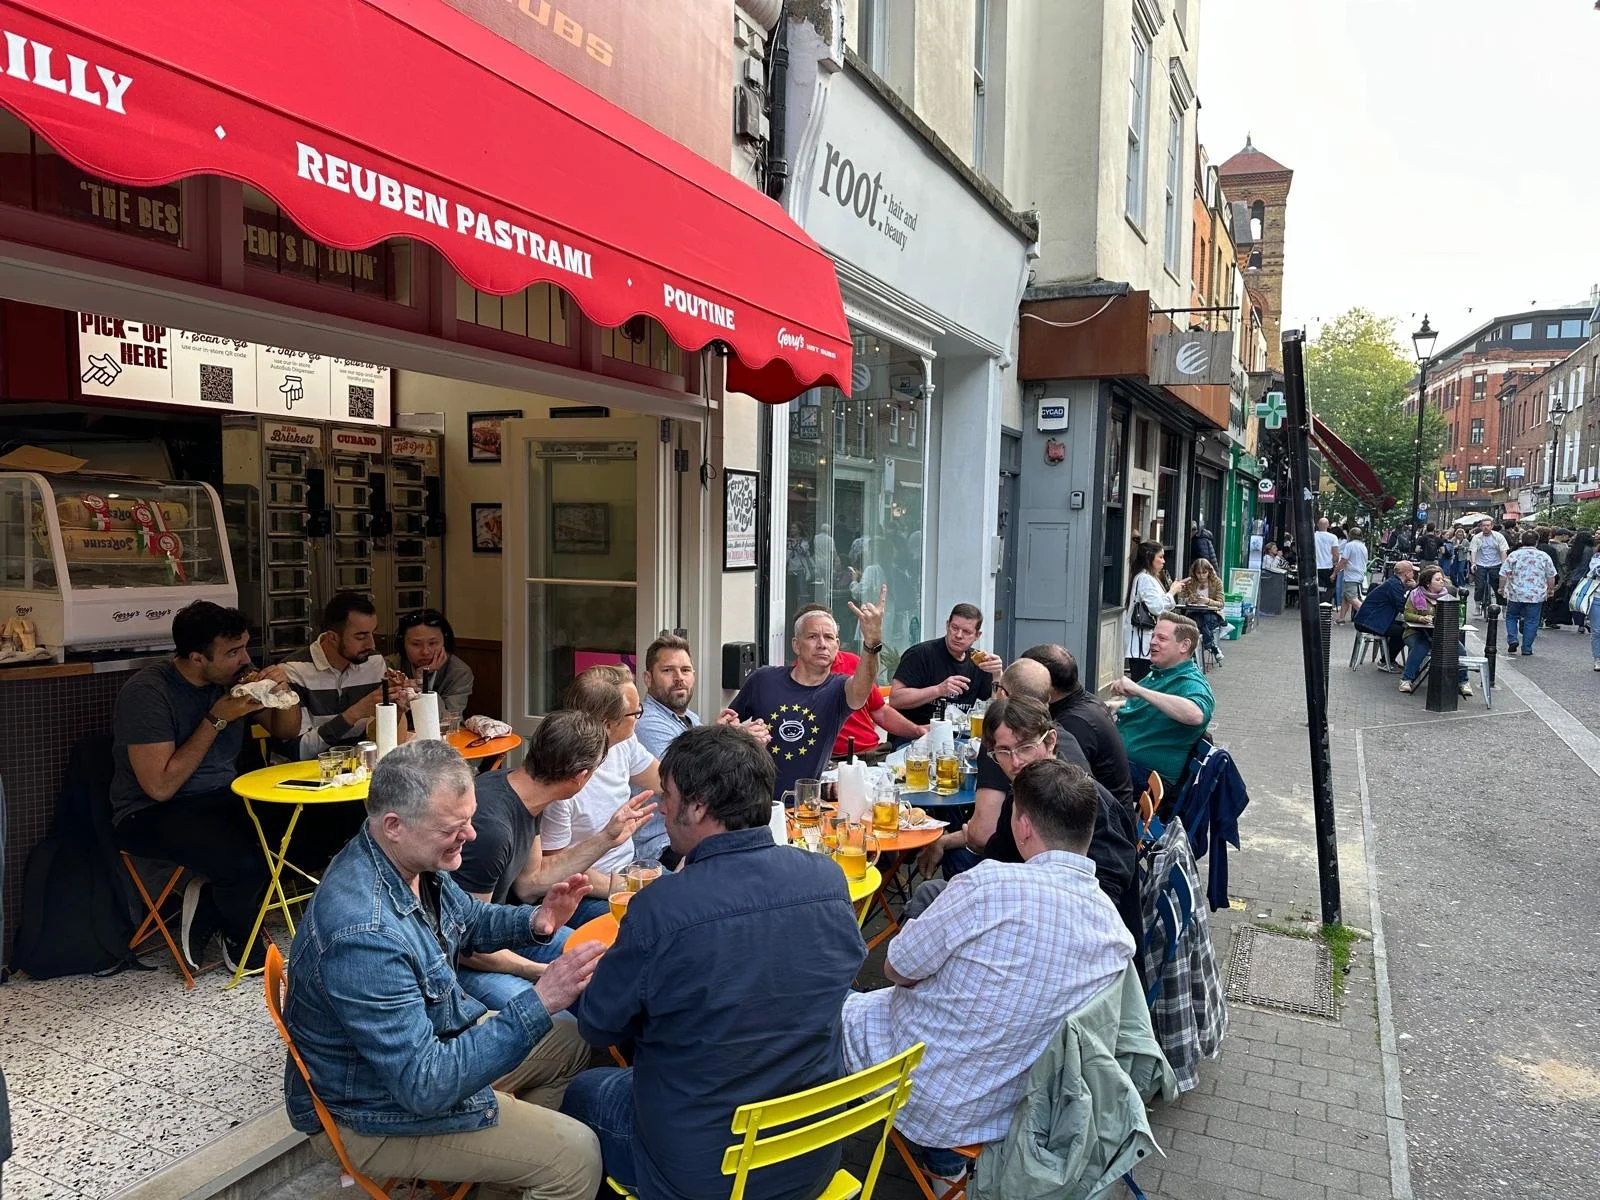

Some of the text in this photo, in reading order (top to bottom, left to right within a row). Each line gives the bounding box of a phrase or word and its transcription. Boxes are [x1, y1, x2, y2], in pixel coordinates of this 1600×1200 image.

[505, 0, 614, 67] UBS
[0, 30, 133, 115] ILLY
[138, 196, 181, 235] BES
[295, 140, 593, 280] REUBEN PASTRAMI
[888, 194, 918, 232] hair and
[884, 216, 908, 252] beauty
[663, 283, 736, 331] POUTINE
[120, 342, 168, 370] HERE
[777, 327, 805, 352] Gerry's
[336, 434, 377, 447] CUBANO
[729, 489, 758, 514] Vintage
[733, 506, 754, 533] Vinyl
[112, 609, 141, 623] Gerry's
[145, 608, 172, 621] Gerry's
